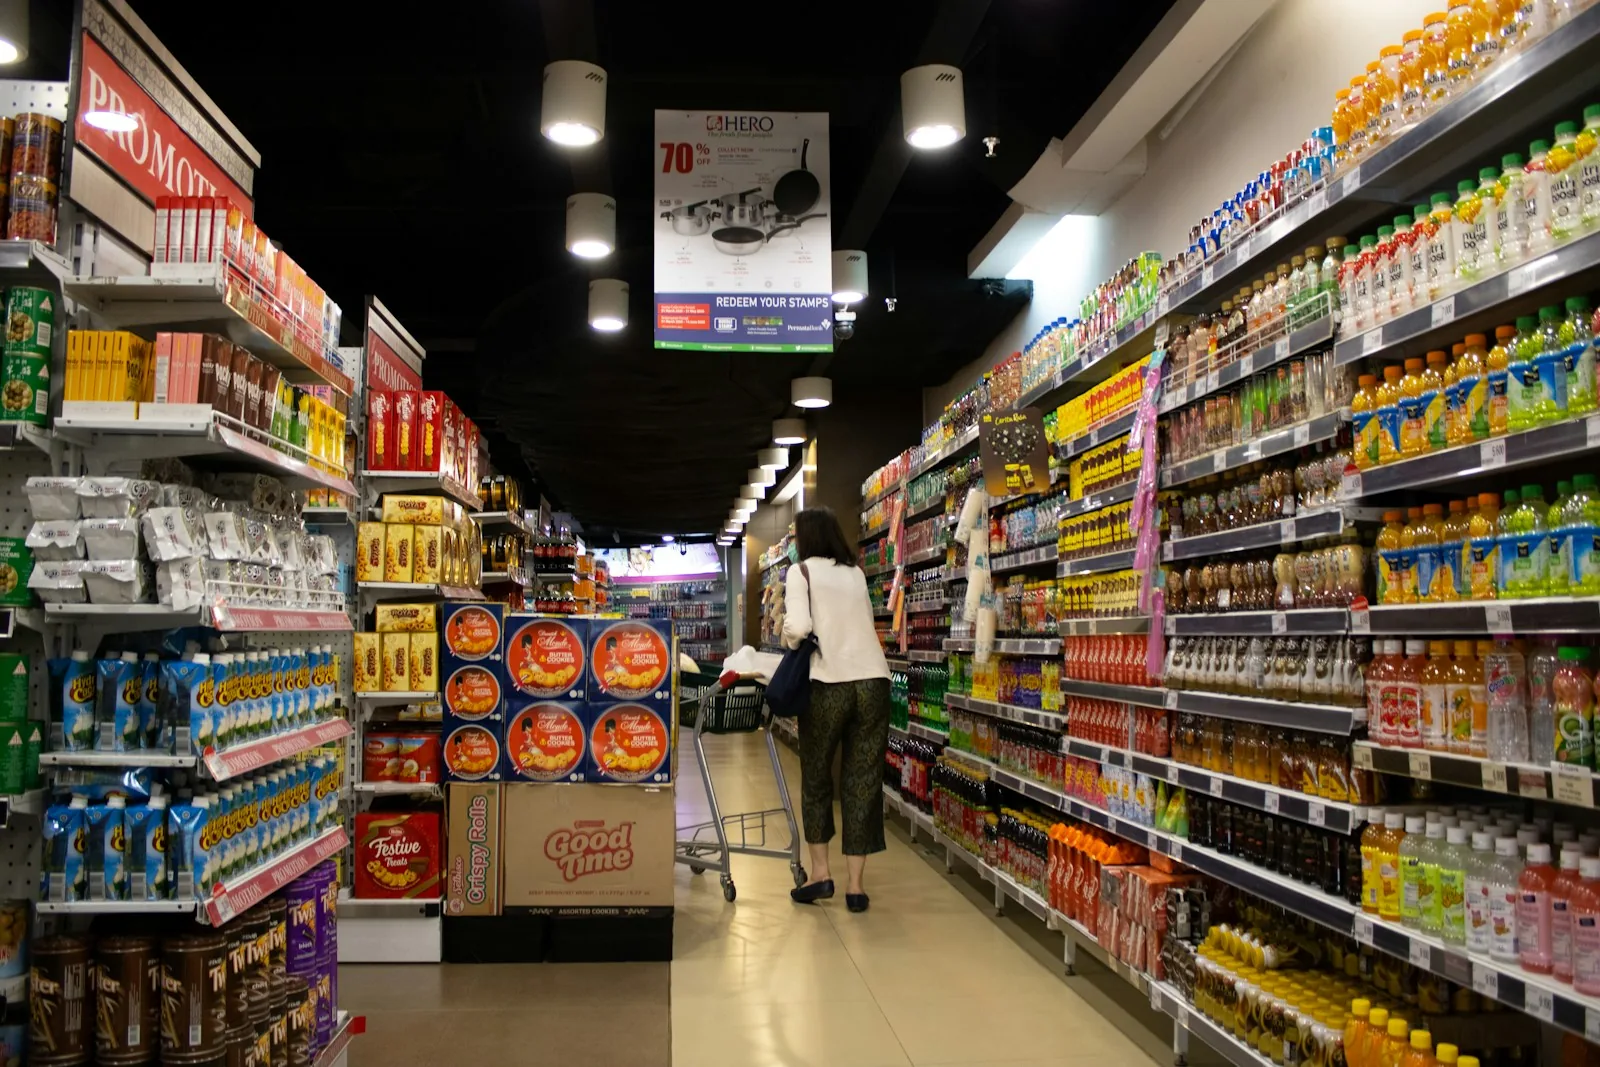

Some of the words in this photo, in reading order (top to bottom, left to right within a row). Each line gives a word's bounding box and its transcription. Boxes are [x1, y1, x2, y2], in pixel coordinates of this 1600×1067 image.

[725, 116, 774, 133] HERO
[696, 158, 711, 166] OFF
[716, 296, 758, 308] REDEEM
[760, 296, 786, 308] YOUR
[788, 297, 829, 309] STAMPS
[72, 675, 95, 690] Hydr
[468, 796, 488, 842] Rolls
[369, 837, 422, 861] Festive
[544, 822, 633, 861] Good
[384, 856, 408, 868] Treats
[558, 848, 633, 882] Time
[466, 844, 490, 903] Crispy
